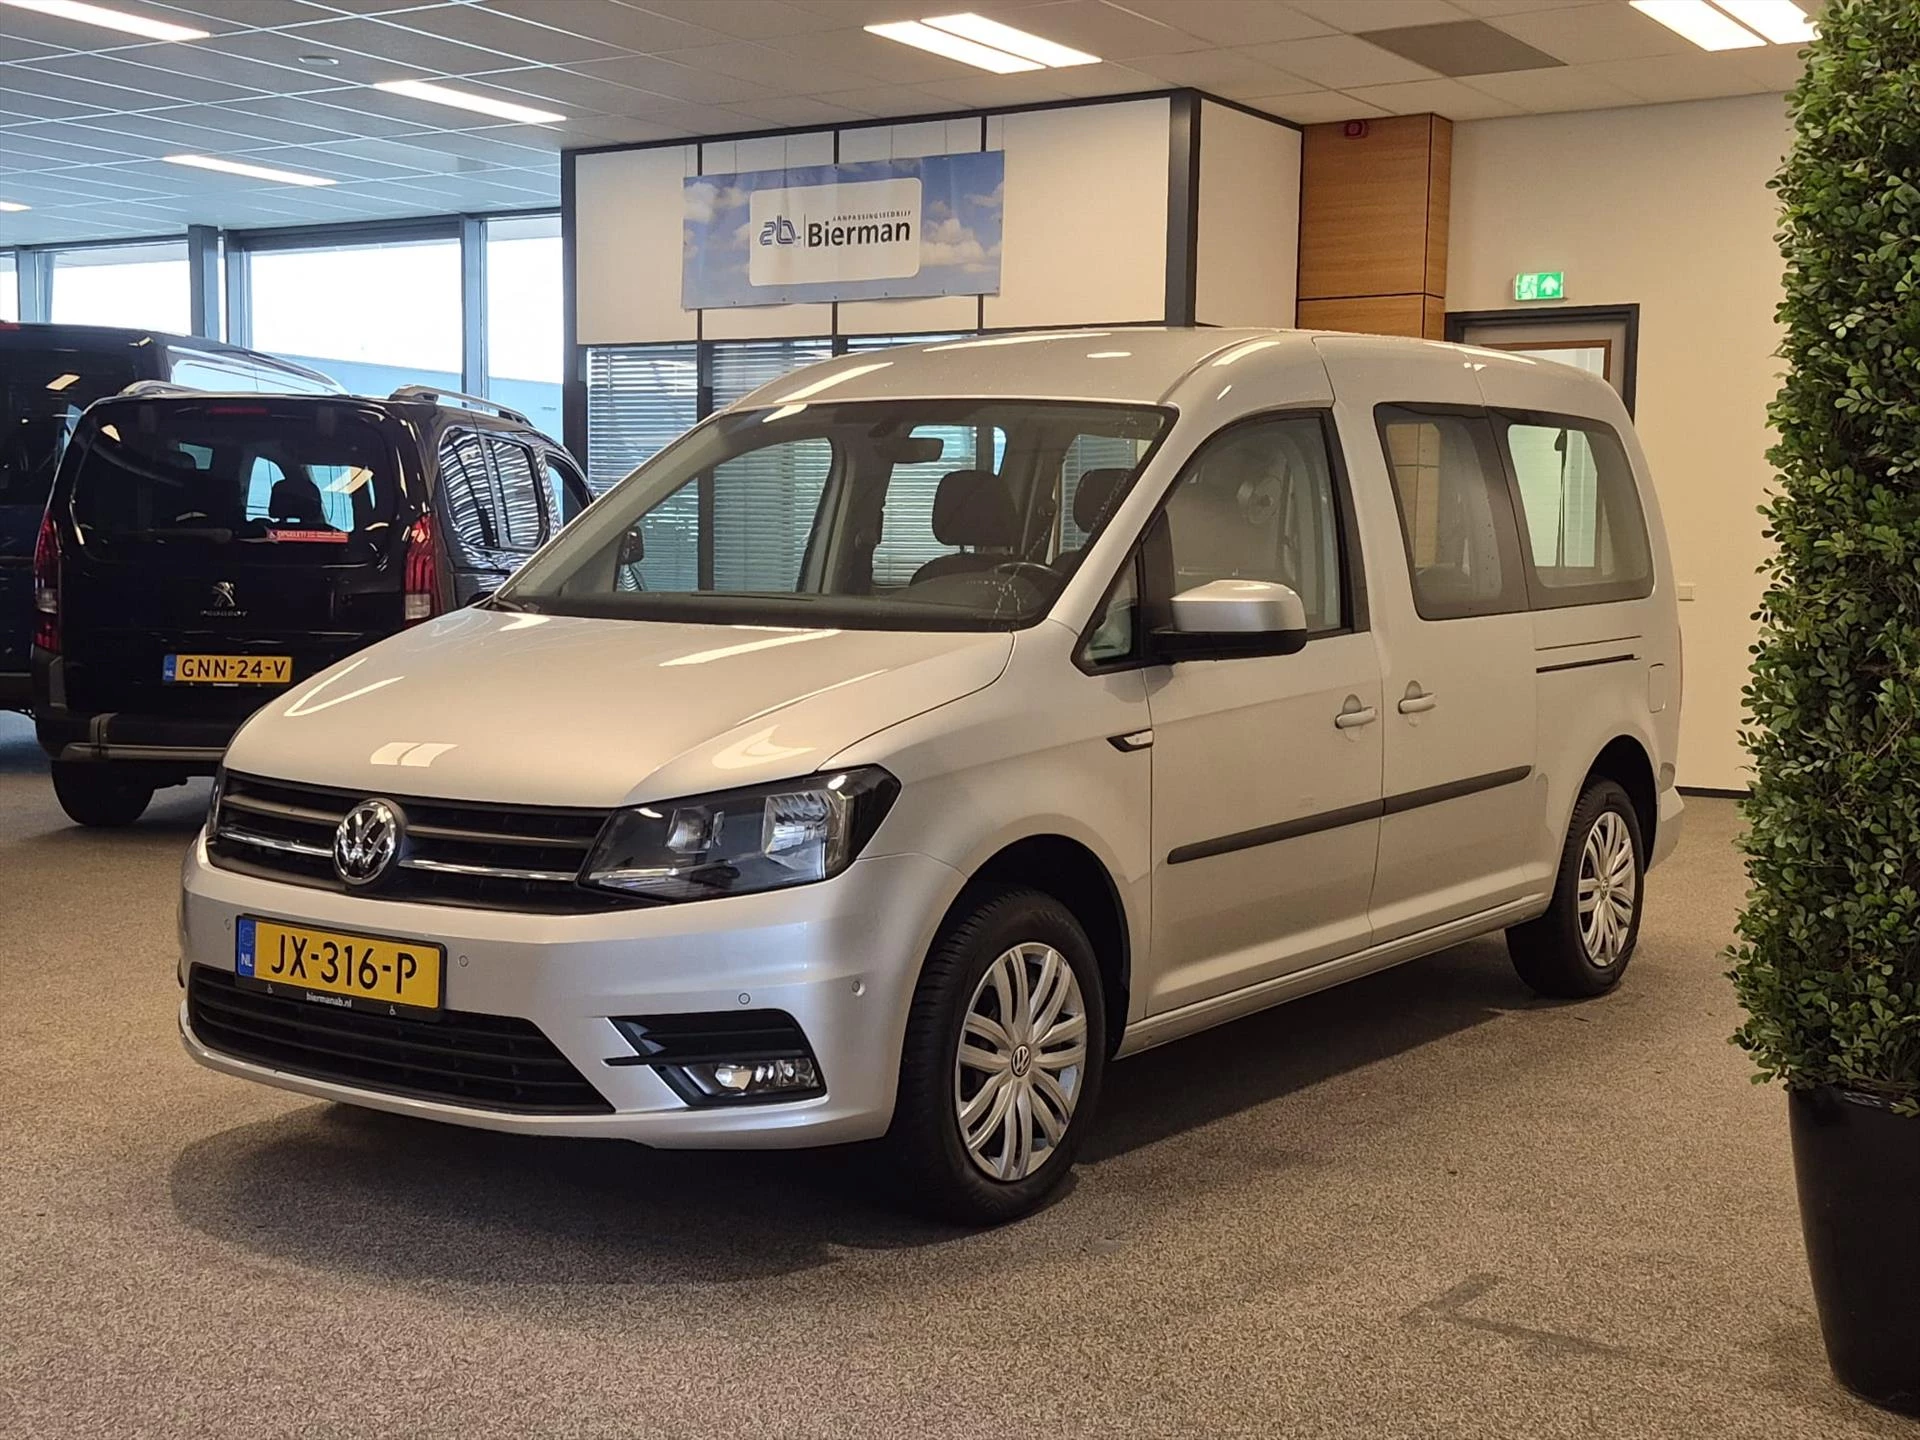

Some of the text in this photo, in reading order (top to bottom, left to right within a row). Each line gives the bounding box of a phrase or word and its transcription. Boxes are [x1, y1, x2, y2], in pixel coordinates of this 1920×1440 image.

[808, 221, 911, 248] Bierman
[182, 659, 286, 679] GNN-24-V
[240, 953, 253, 968] NL
[271, 934, 417, 994] JX-316-P
